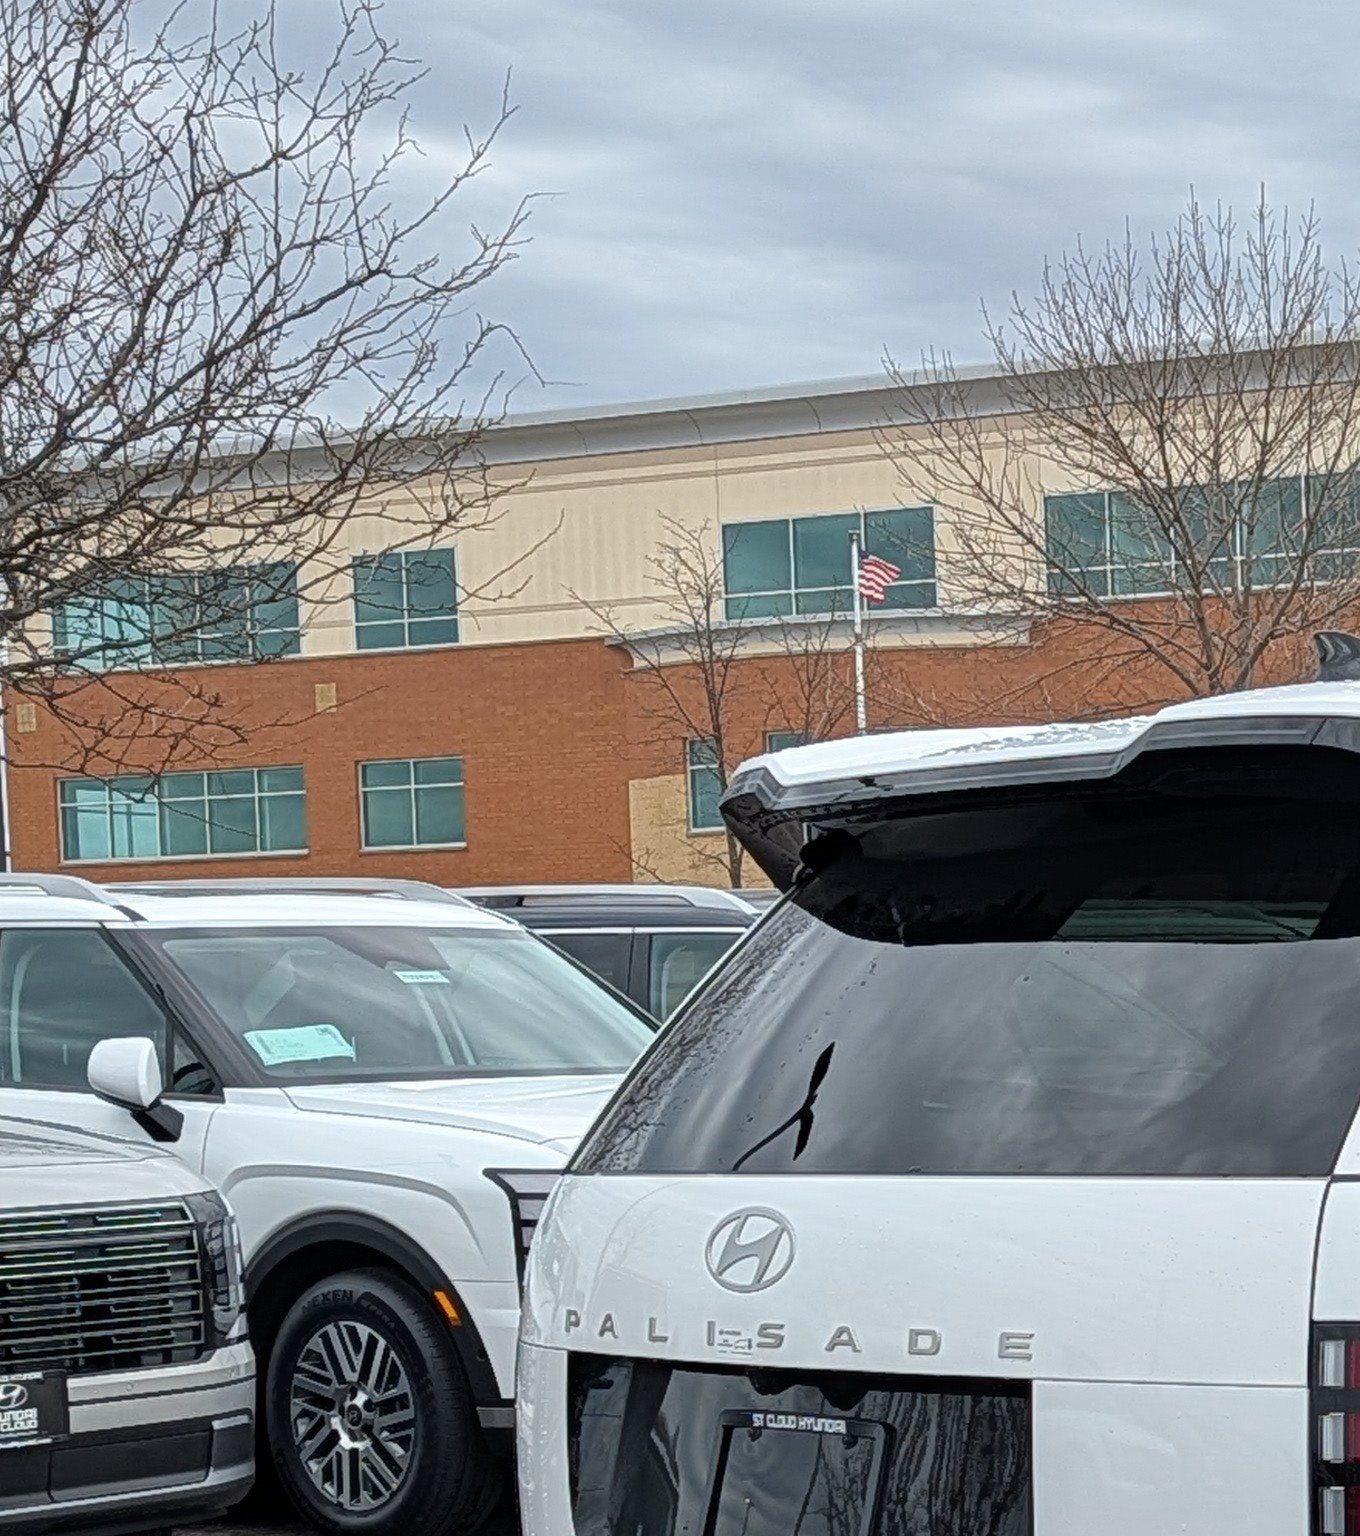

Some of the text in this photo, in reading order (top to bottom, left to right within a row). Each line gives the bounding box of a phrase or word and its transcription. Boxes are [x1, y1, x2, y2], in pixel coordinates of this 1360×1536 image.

[564, 1309, 1036, 1362] PALISADE
[766, 1413, 797, 1430] CLOUD
[797, 1416, 847, 1434] HYUNDAI
